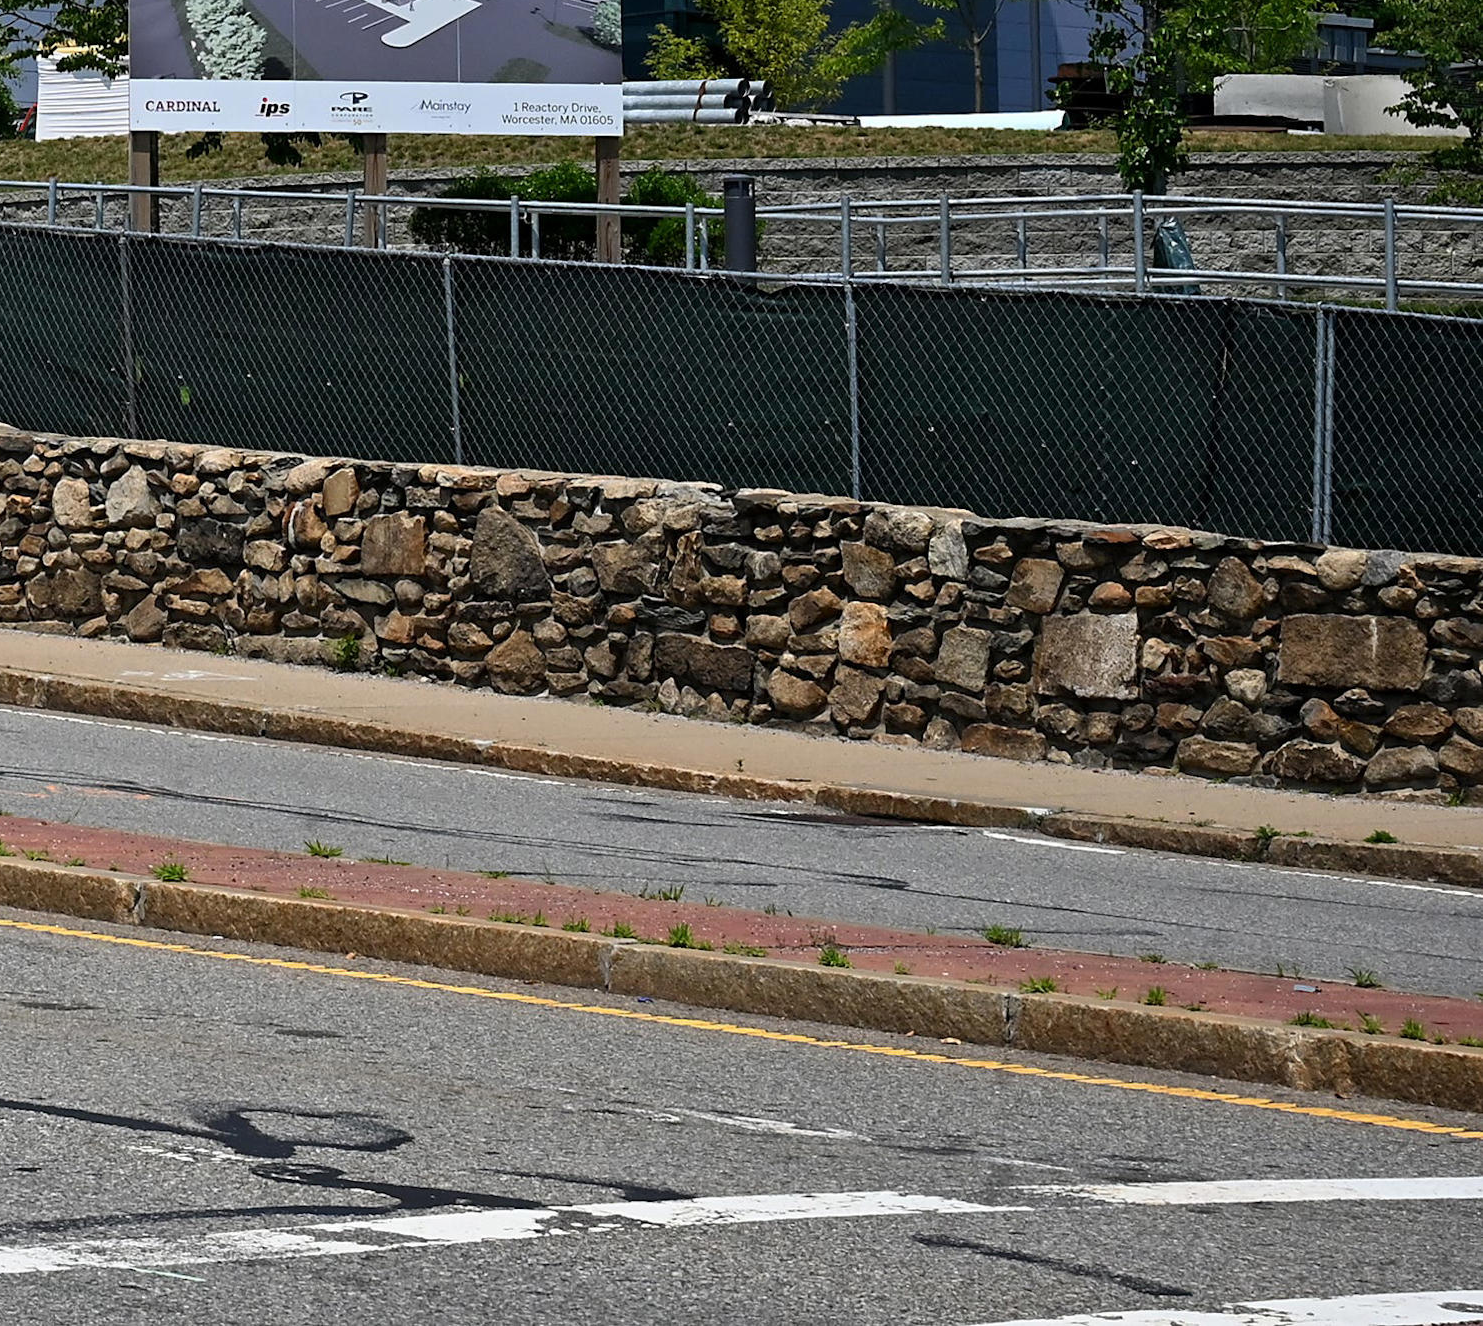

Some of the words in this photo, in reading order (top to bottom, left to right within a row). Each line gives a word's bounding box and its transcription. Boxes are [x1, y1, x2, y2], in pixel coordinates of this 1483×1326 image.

[145, 100, 220, 112] CARDINAL
[259, 97, 291, 117] ips
[420, 99, 471, 114] Mainstay
[514, 102, 518, 112] 1
[522, 102, 568, 114] Reactory
[560, 115, 578, 124] MA
[580, 115, 614, 125] 01605
